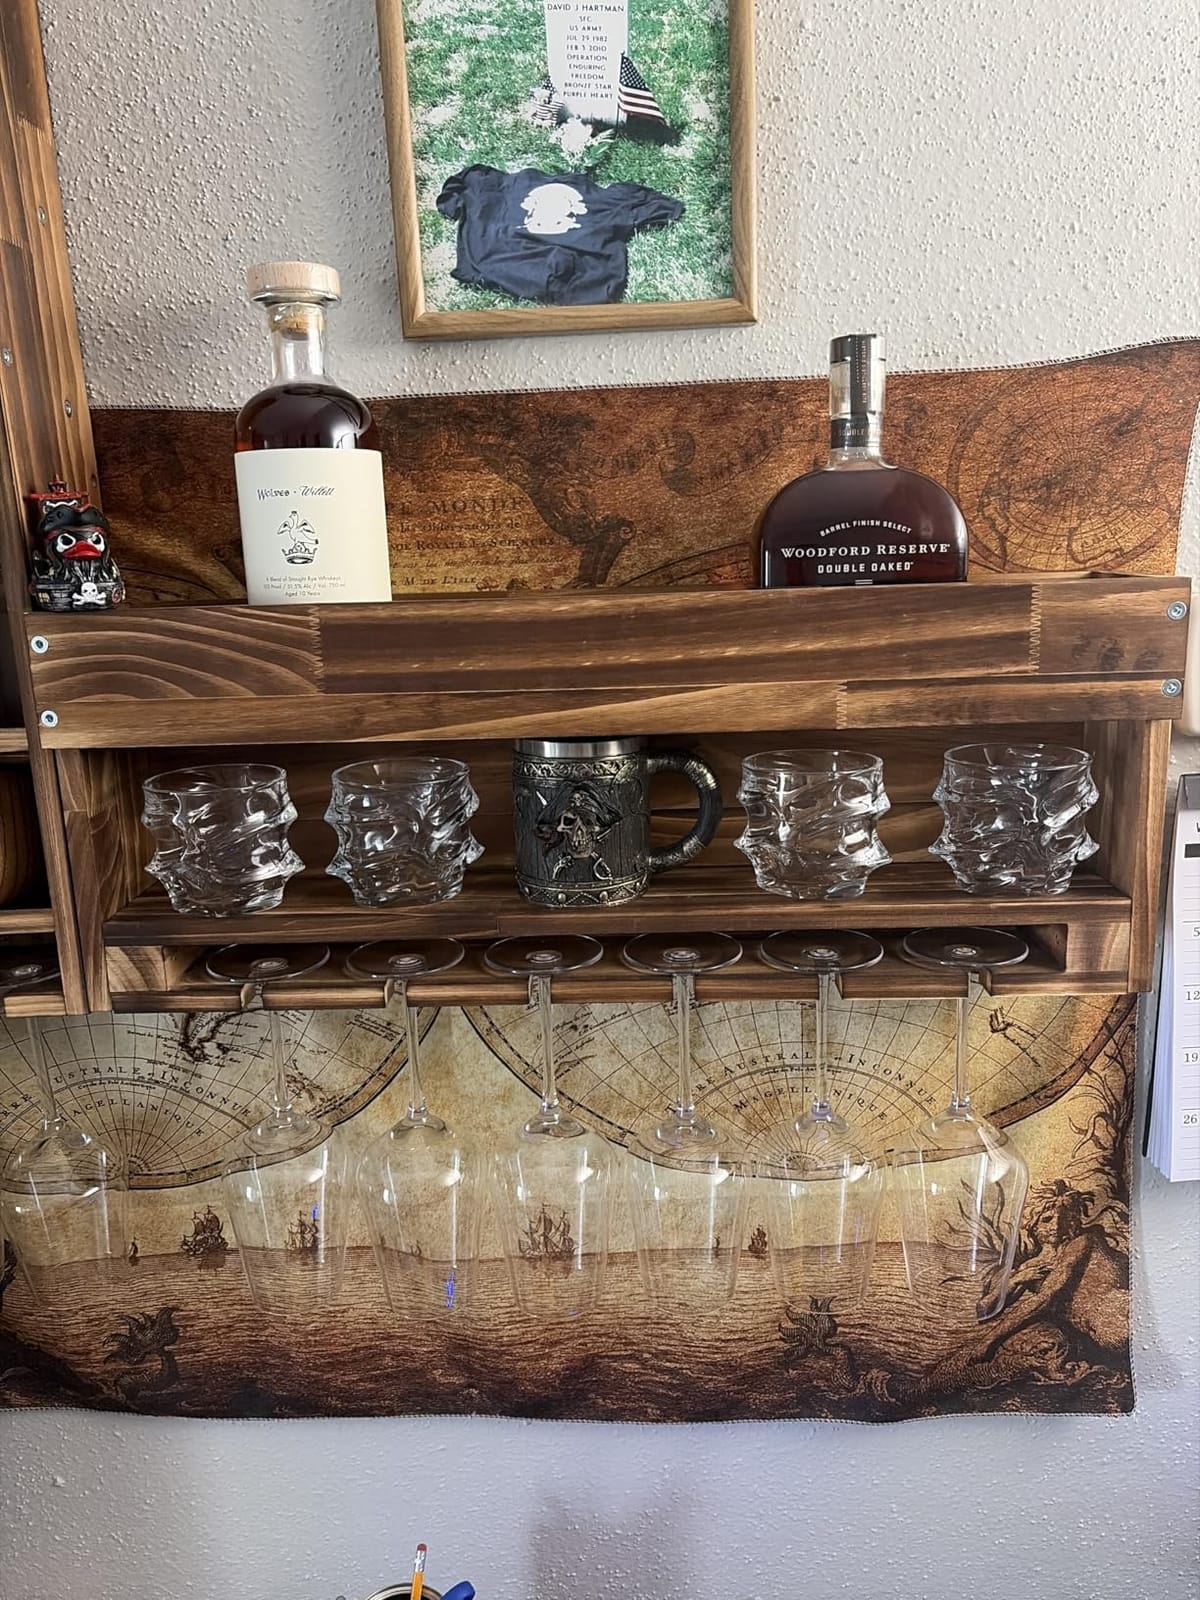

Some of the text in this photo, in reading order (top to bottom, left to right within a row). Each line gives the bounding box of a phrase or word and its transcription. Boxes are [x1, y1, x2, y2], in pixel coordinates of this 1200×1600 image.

[582, 4, 625, 12] HARTMAN
[566, 54, 608, 62] OPERATION
[569, 63, 606, 71] ENDURING
[590, 92, 613, 100] HEART
[819, 519, 912, 538] BARREL FINISH SELECT
[781, 544, 950, 559] WOODFORD RESERVE
[817, 562, 914, 574] DOUBLE OAKED
[1187, 991, 1200, 1000] 12
[1185, 1053, 1198, 1062] 19
[54, 1066, 141, 1084] USTRALE
[724, 1052, 813, 1077] AUSTRAL
[848, 1053, 937, 1105] INCONNUE
[733, 1086, 888, 1121] MAGELLNIQUE
[1184, 1114, 1198, 1124] 26
